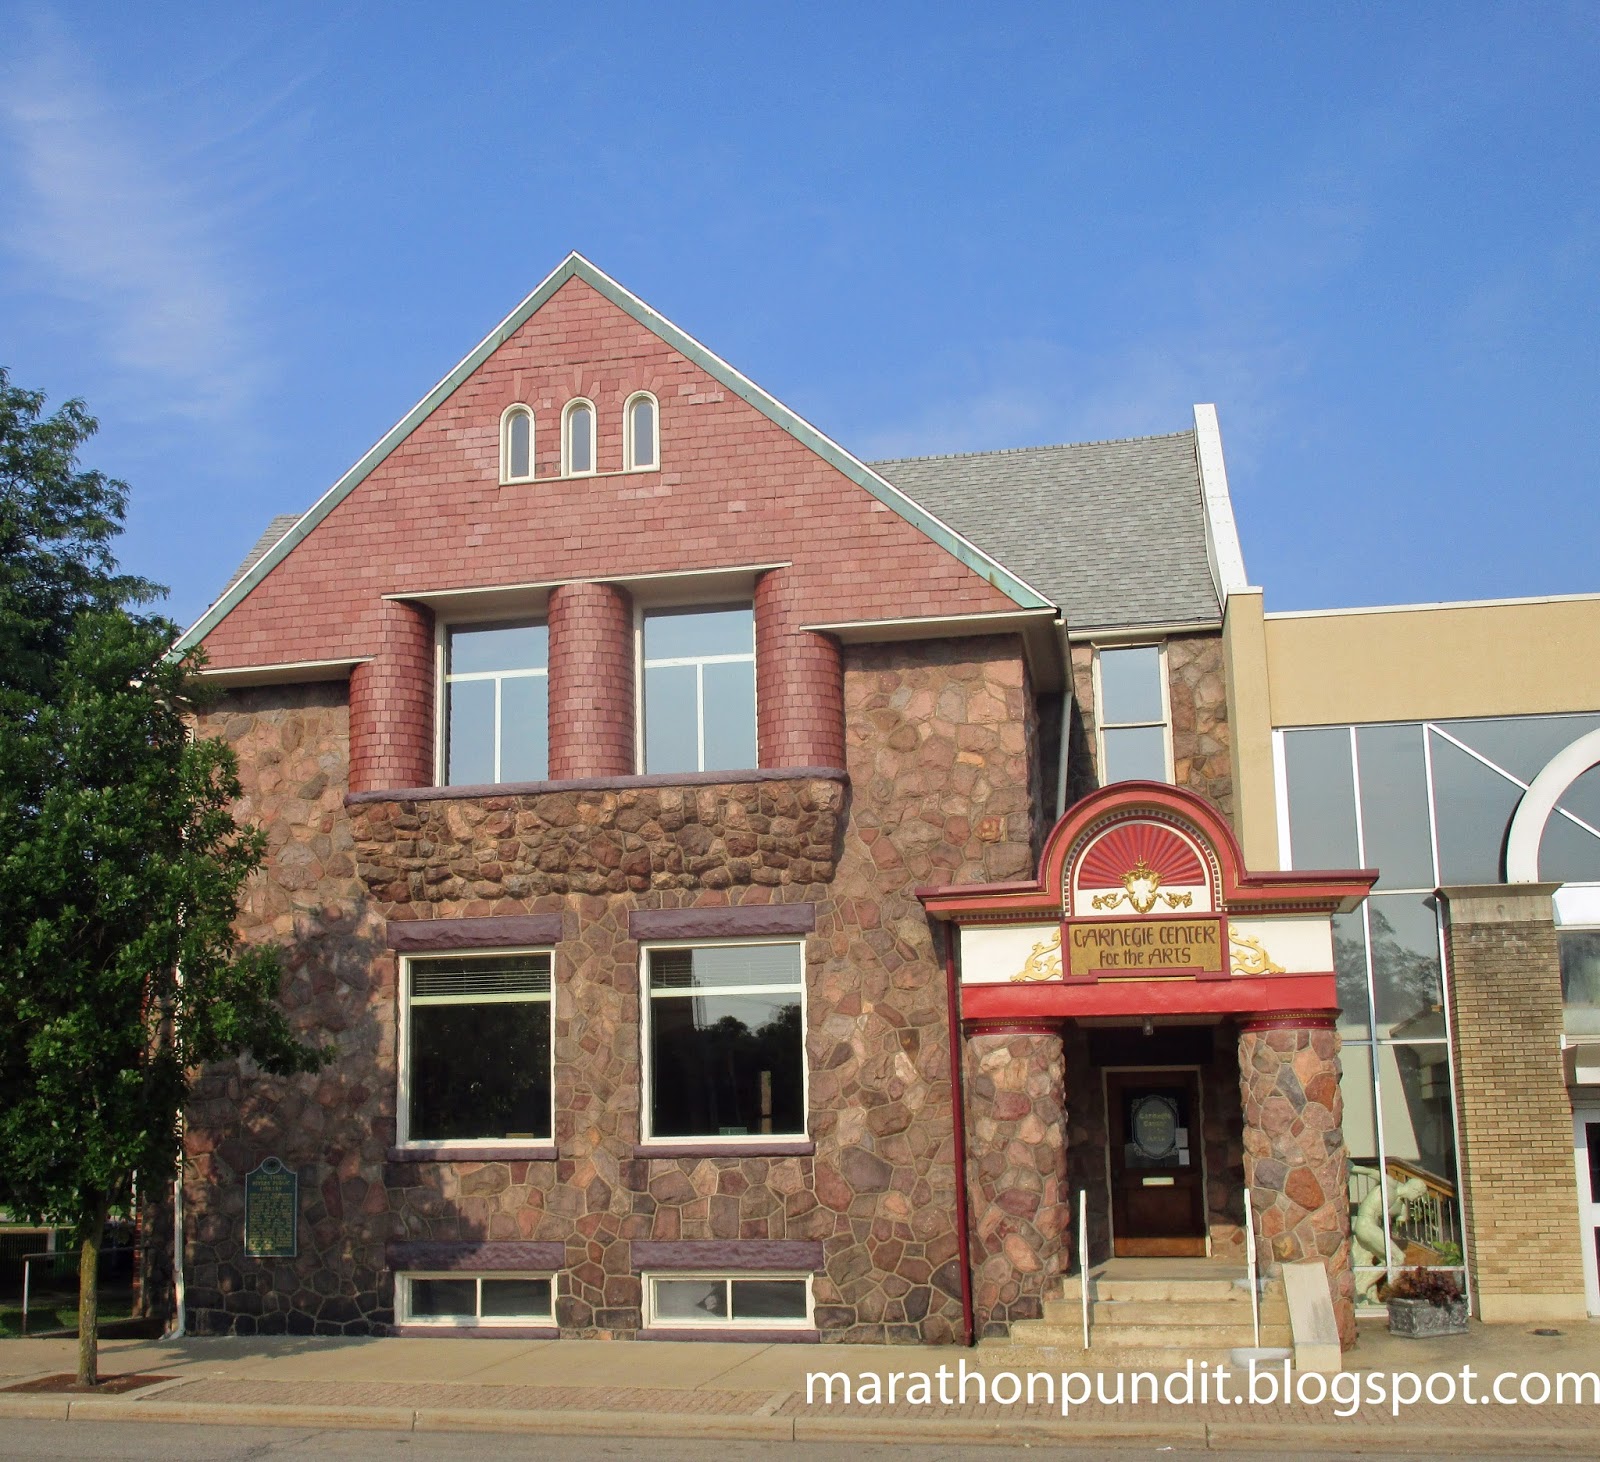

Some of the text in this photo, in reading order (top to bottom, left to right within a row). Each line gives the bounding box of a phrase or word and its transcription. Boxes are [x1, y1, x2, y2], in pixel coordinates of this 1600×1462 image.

[1073, 925, 1216, 948] CARNEGIE CENTER
[1124, 949, 1144, 966] the
[1148, 947, 1191, 965] ARTS
